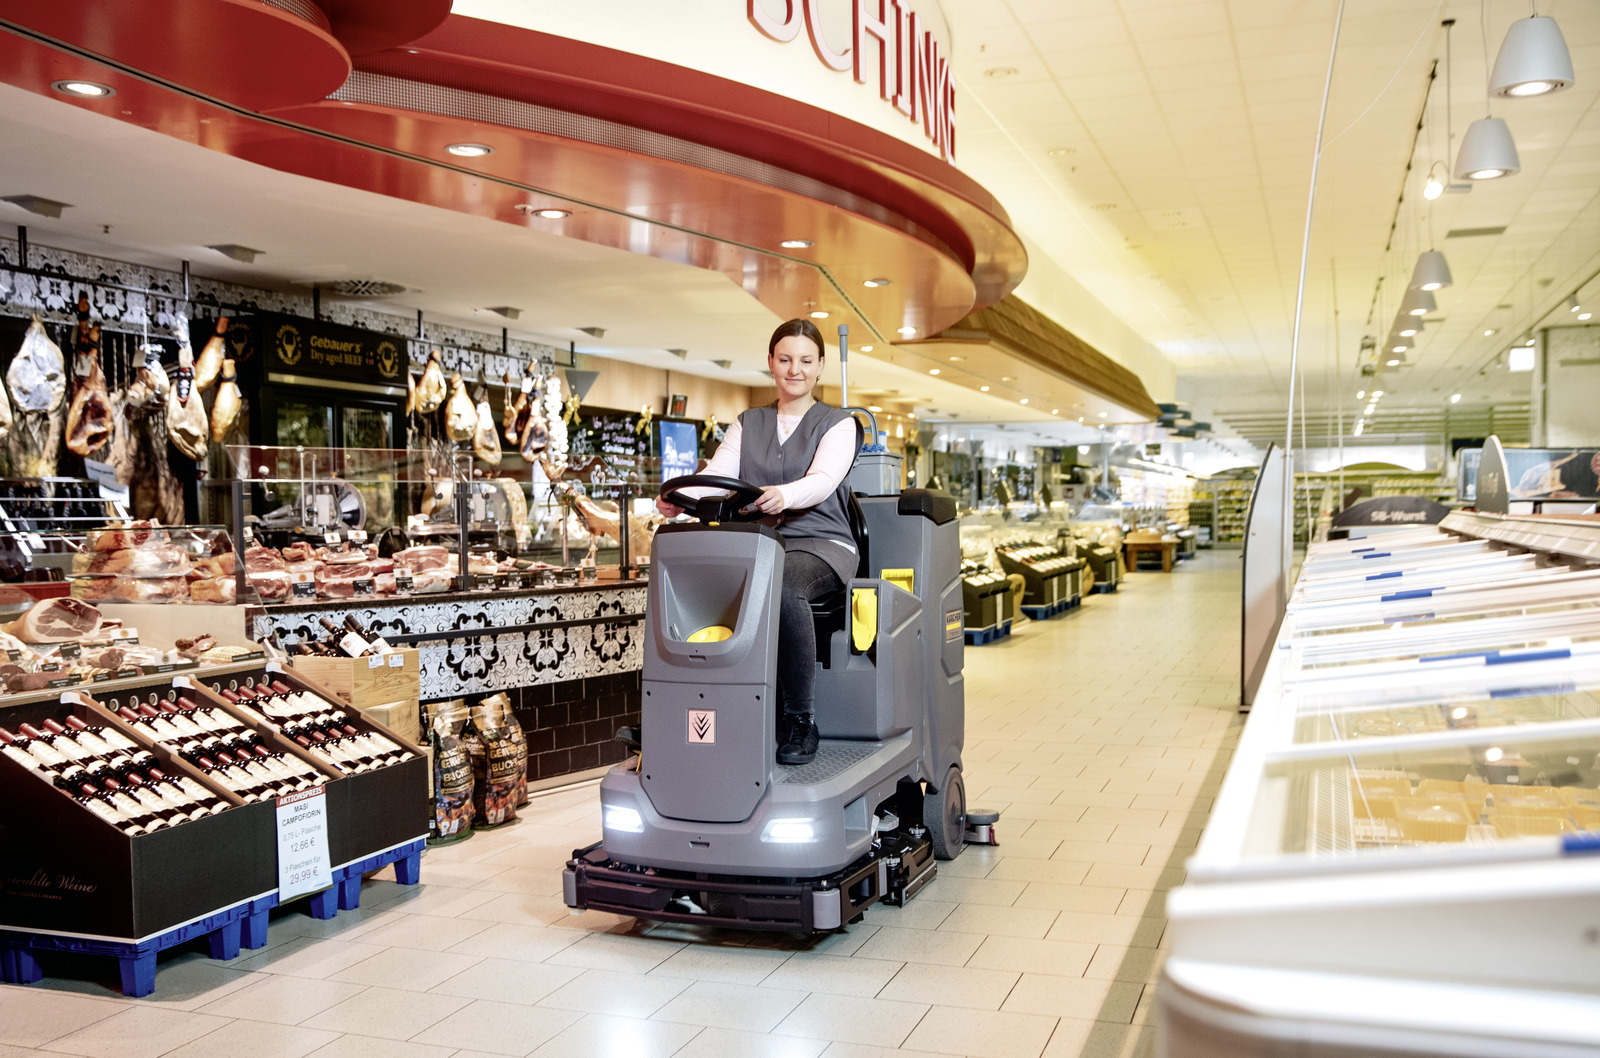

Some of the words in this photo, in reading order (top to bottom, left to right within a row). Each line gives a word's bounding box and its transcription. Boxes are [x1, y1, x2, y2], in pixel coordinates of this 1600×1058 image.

[310, 335, 362, 353] Gebauer's
[310, 348, 325, 364] Dry
[325, 352, 343, 366] aged
[344, 352, 363, 367] BEEF
[1371, 510, 1427, 522] SB-Wurst
[279, 786, 323, 806] AKTIONSPREIS
[294, 803, 309, 813] MASI
[282, 808, 321, 827] CAMPOFIORIN
[302, 824, 321, 835] Flasche
[290, 839, 308, 854] 12,66
[310, 837, 315, 847] €
[285, 866, 289, 874] 3
[289, 858, 313, 872] Flaschen
[313, 856, 321, 865] für
[58, 874, 98, 893] Weine
[290, 869, 311, 885] 29,99
[313, 866, 318, 877] €
